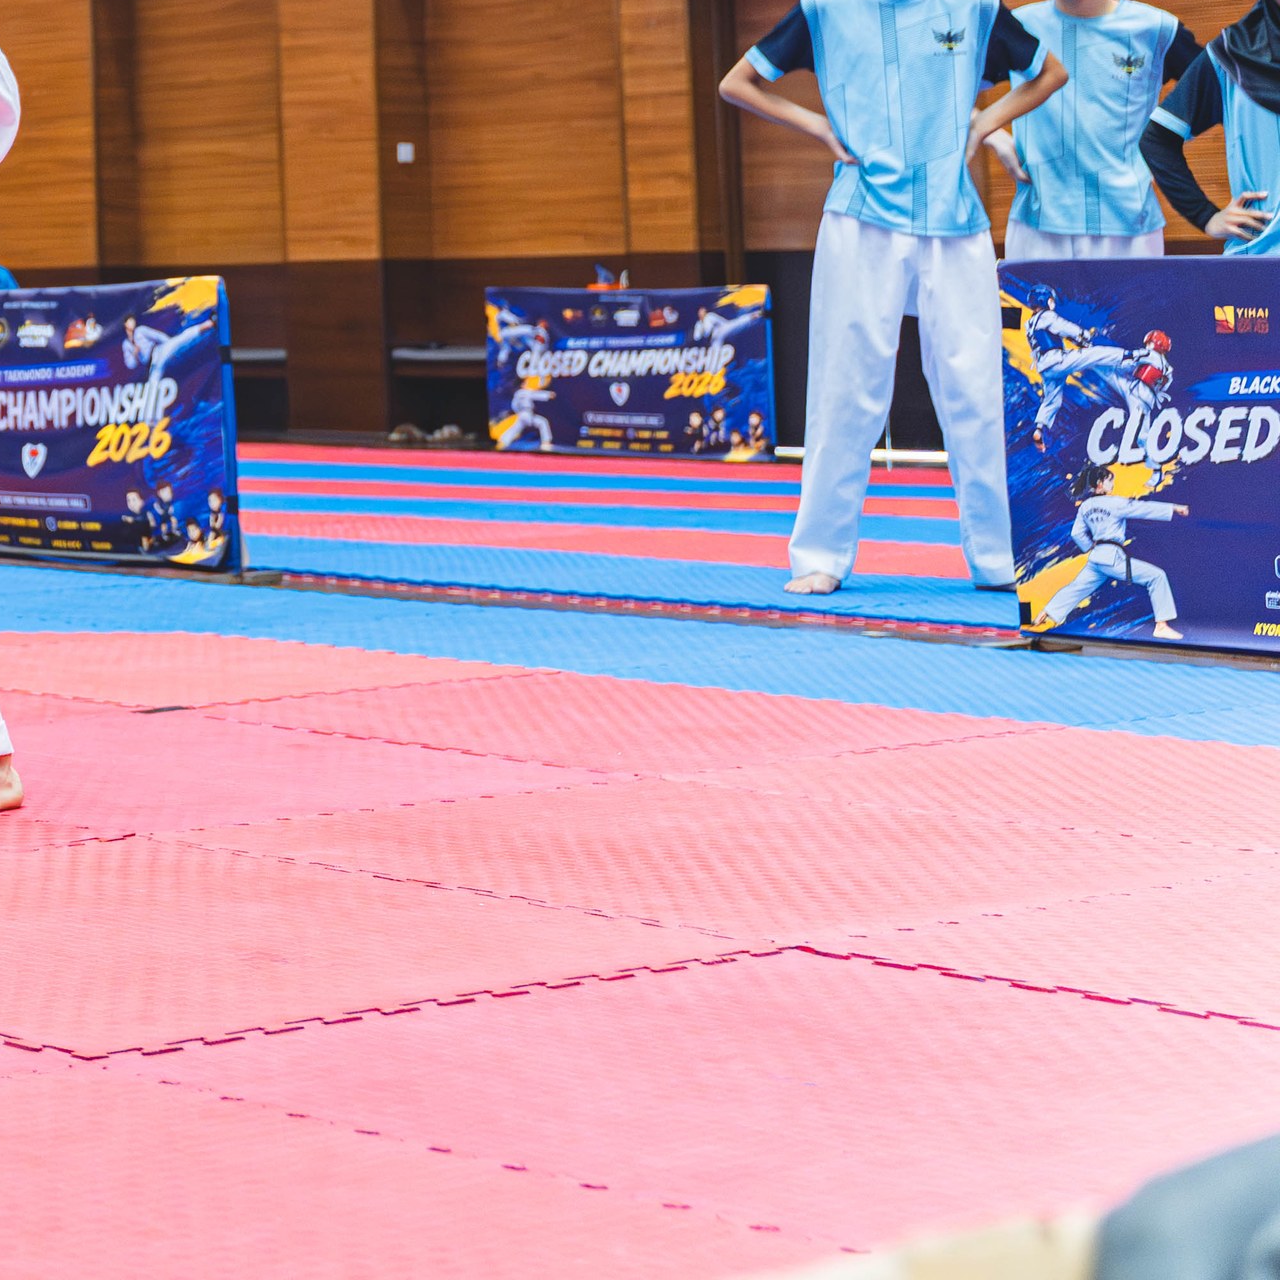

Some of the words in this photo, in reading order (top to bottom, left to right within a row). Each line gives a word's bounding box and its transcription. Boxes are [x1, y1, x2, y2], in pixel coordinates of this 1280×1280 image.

[1236, 306, 1269, 319] YIHAI
[515, 349, 589, 379] CLOSED
[587, 343, 736, 378] CHAMPIONSHIP
[663, 367, 727, 400] 2026
[1228, 375, 1280, 396] BLACK
[86, 416, 172, 468] 2026
[1086, 405, 1280, 466] CLOSED
